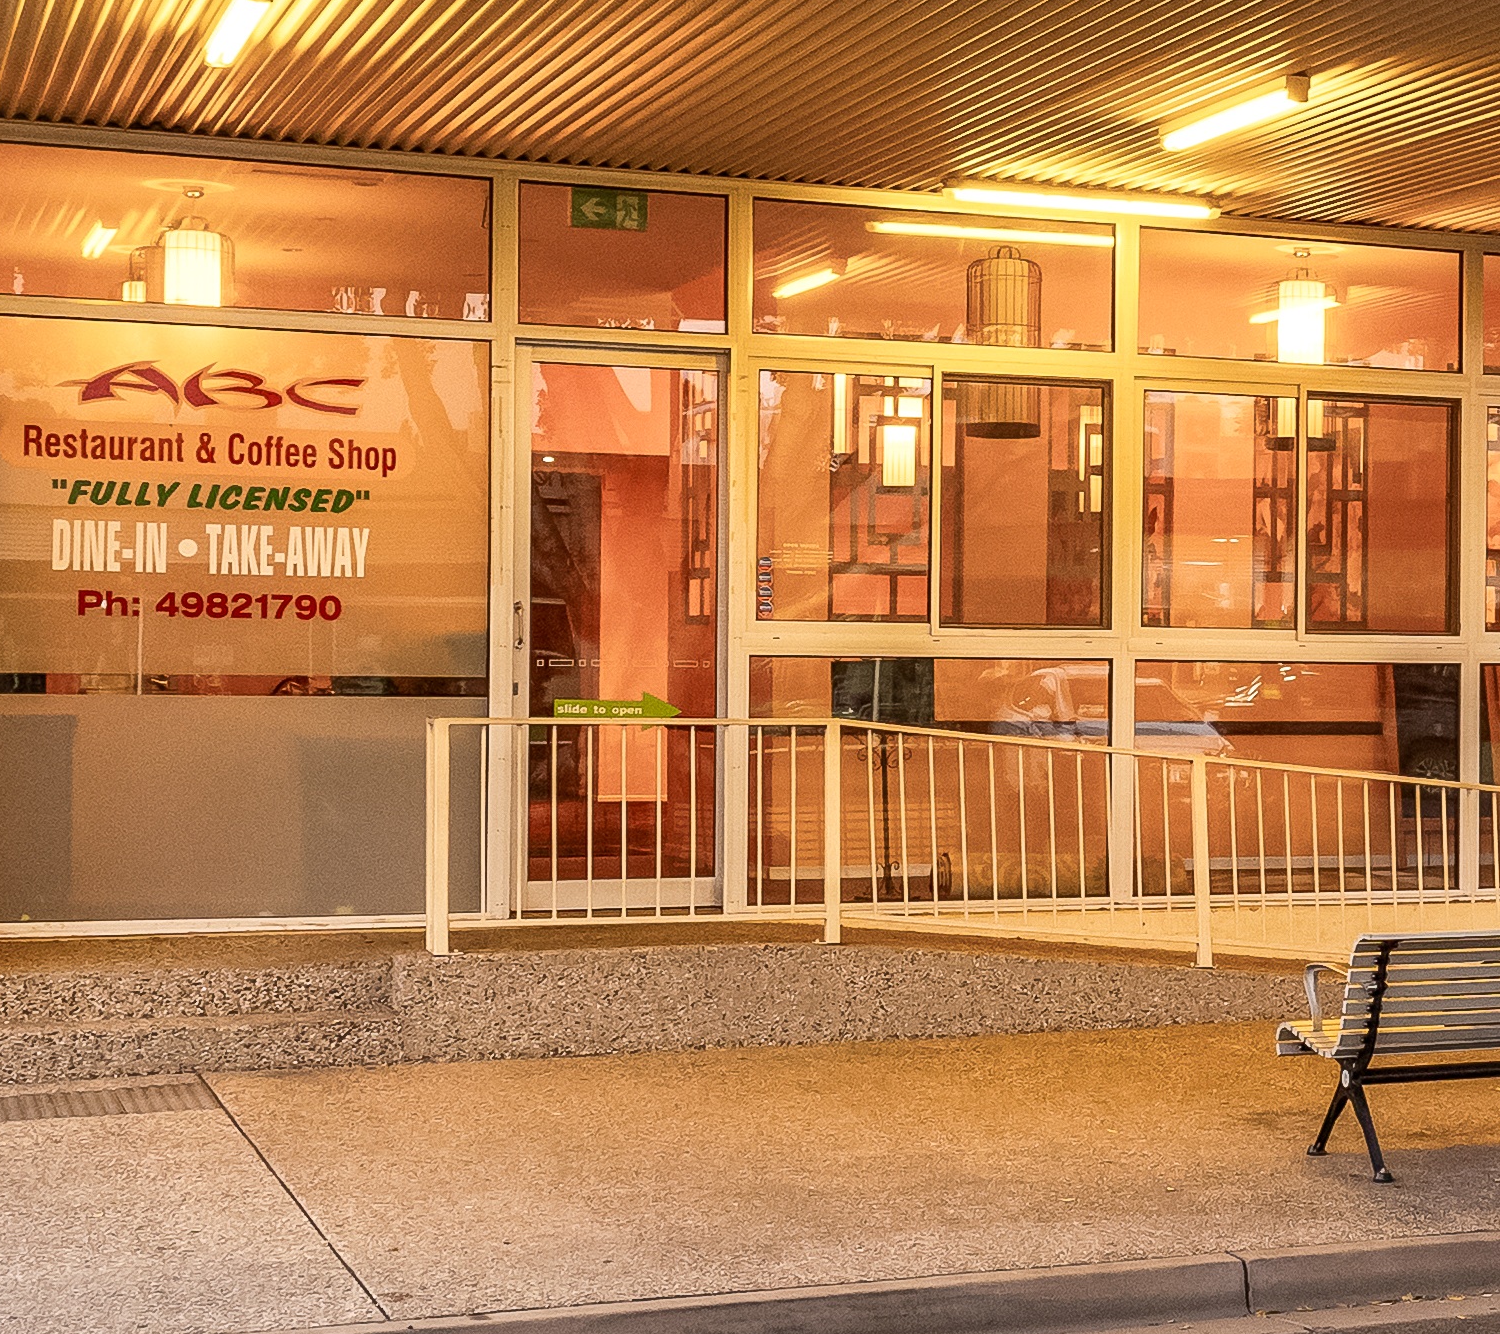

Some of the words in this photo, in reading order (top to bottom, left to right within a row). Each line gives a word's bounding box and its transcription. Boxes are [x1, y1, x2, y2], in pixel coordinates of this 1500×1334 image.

[58, 360, 368, 417] ABC
[23, 424, 184, 463] Restaurant
[196, 432, 216, 465] &
[227, 433, 318, 469] Coffee
[328, 438, 398, 478] Shop
[52, 479, 180, 508] "FULLY
[187, 484, 370, 514] LICENSED"
[52, 519, 168, 574] DINE-IN
[205, 523, 370, 578] TAKE-AWAY
[77, 590, 140, 618] Ph:
[155, 591, 342, 621] 49821790
[557, 704, 588, 714] slide
[594, 705, 606, 714] to
[612, 707, 643, 716] open
